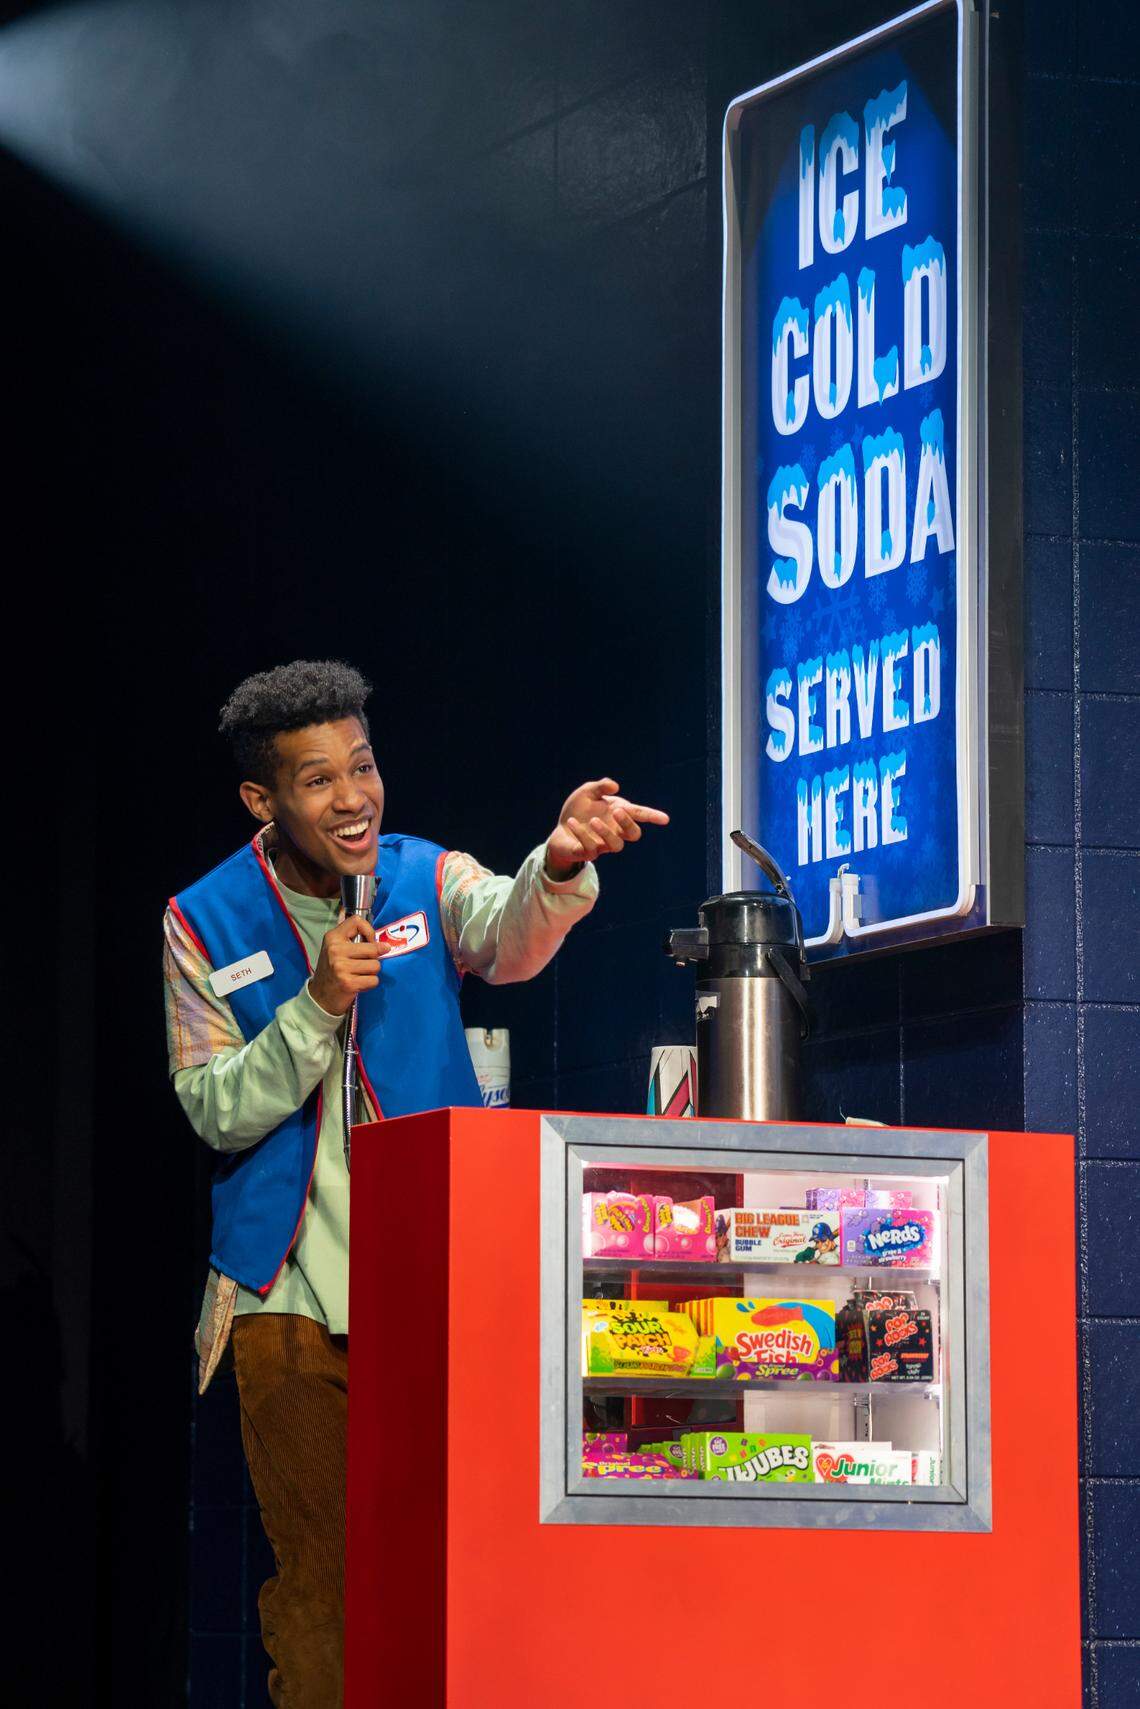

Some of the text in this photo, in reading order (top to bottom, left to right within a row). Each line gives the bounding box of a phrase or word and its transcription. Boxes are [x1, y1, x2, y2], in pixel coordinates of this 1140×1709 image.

[799, 80, 908, 270] ICE
[771, 235, 948, 437] COLD
[767, 408, 956, 605] SODA
[766, 620, 941, 763] SERVED
[797, 749, 909, 867] HERE
[230, 967, 252, 981] SETH
[735, 1212, 800, 1226] BIG LEAGUE
[735, 1225, 771, 1238] CHEW
[611, 1320, 664, 1335] SOUR
[885, 1313, 909, 1333] POP
[610, 1332, 672, 1350] PATCH
[736, 1329, 813, 1357] Swedish
[754, 1349, 798, 1367] Fish
[872, 1352, 891, 1369] POP
[755, 1364, 799, 1377] Spree
[831, 1459, 898, 1477] Junior
